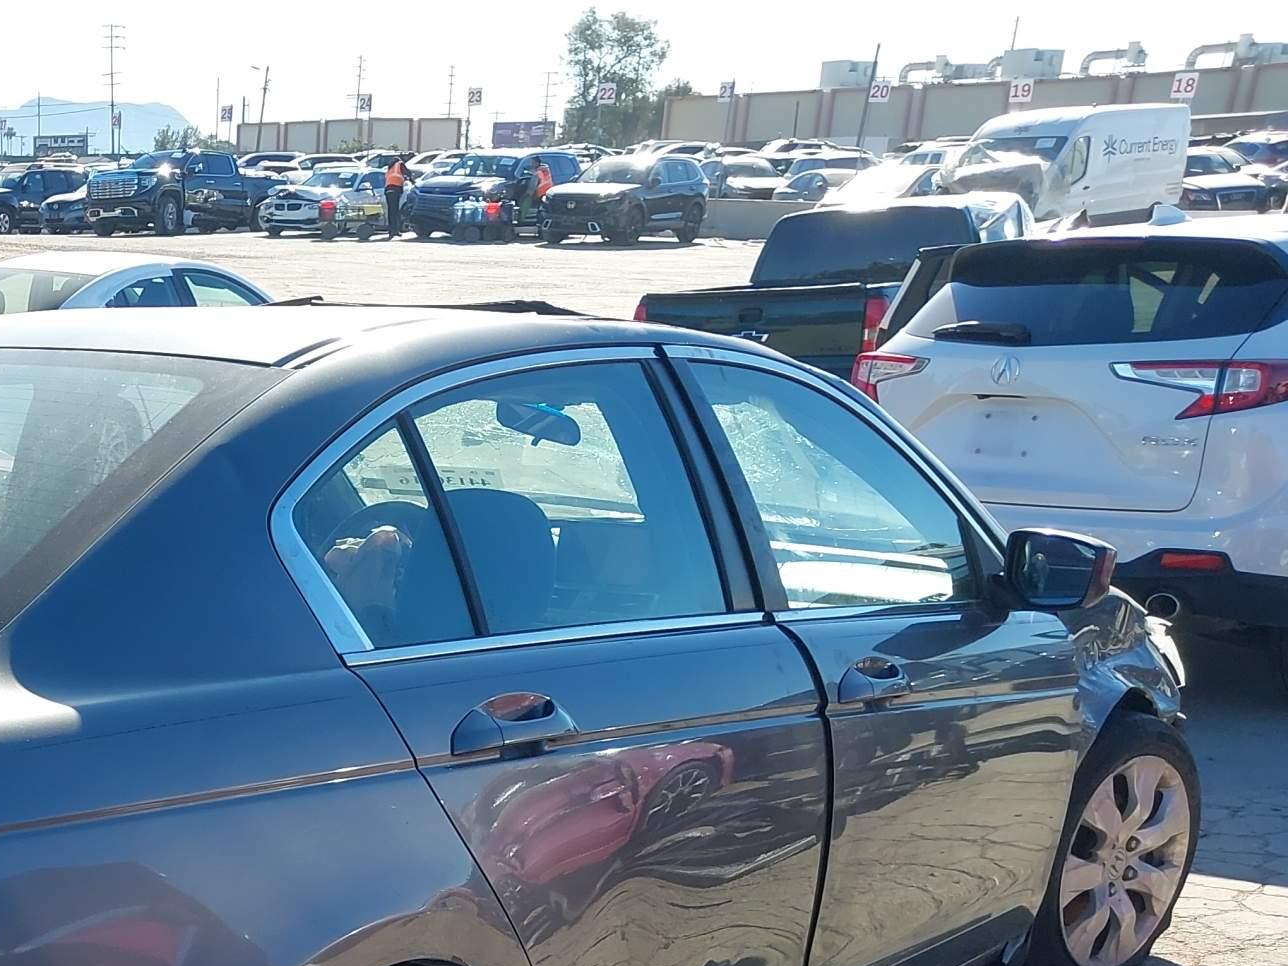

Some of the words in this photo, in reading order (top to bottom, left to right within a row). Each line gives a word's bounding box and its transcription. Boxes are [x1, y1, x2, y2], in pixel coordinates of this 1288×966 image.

[600, 87, 615, 100] 22
[870, 84, 890, 98] 20
[1011, 84, 1031, 98] 19
[1172, 79, 1195, 94] 18
[360, 97, 371, 110] 24
[468, 90, 482, 103] 23
[1119, 139, 1151, 155] Current
[1153, 136, 1178, 155] Energy
